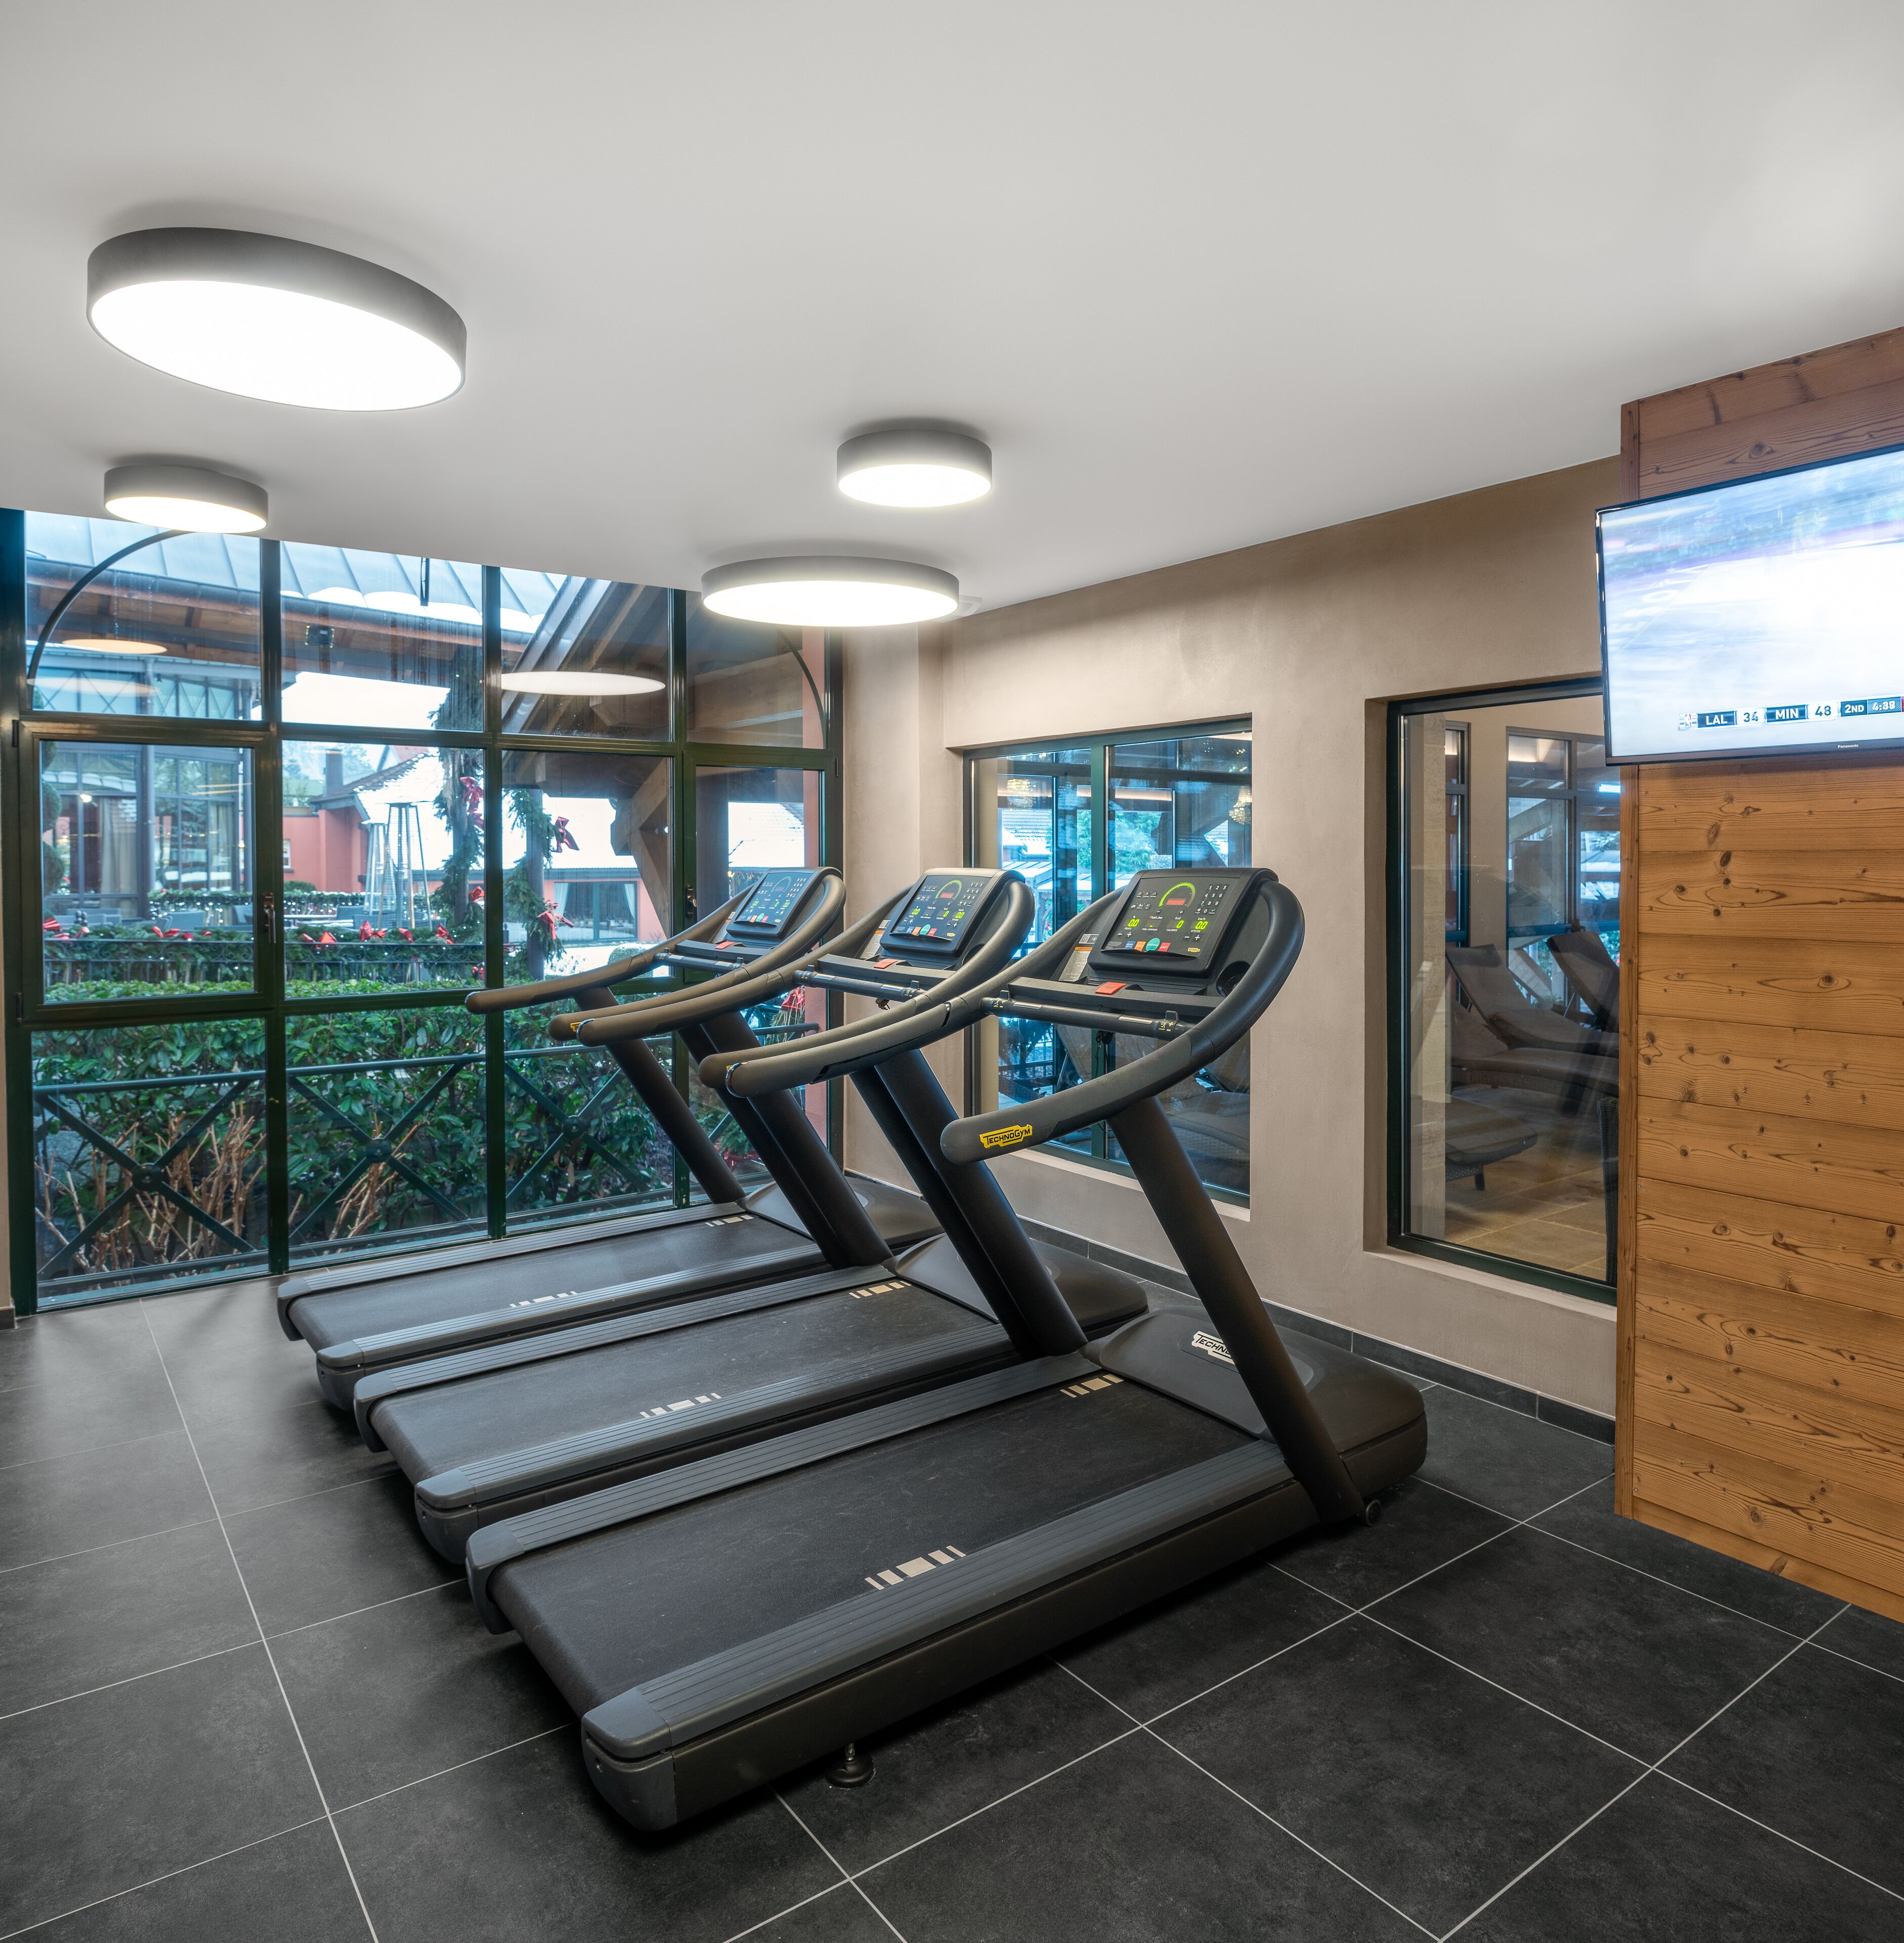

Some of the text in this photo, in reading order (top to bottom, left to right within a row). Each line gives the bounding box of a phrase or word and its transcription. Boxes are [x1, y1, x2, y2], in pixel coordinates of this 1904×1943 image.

[1706, 714, 1727, 725] LAL
[1775, 708, 1799, 720] MIN
[1815, 705, 1832, 716] 48
[1845, 704, 1864, 713] 2ND
[1176, 920, 1184, 928] 0
[983, 1128, 1030, 1145] TECHNOGYM
[1197, 1333, 1230, 1355] TECHN
